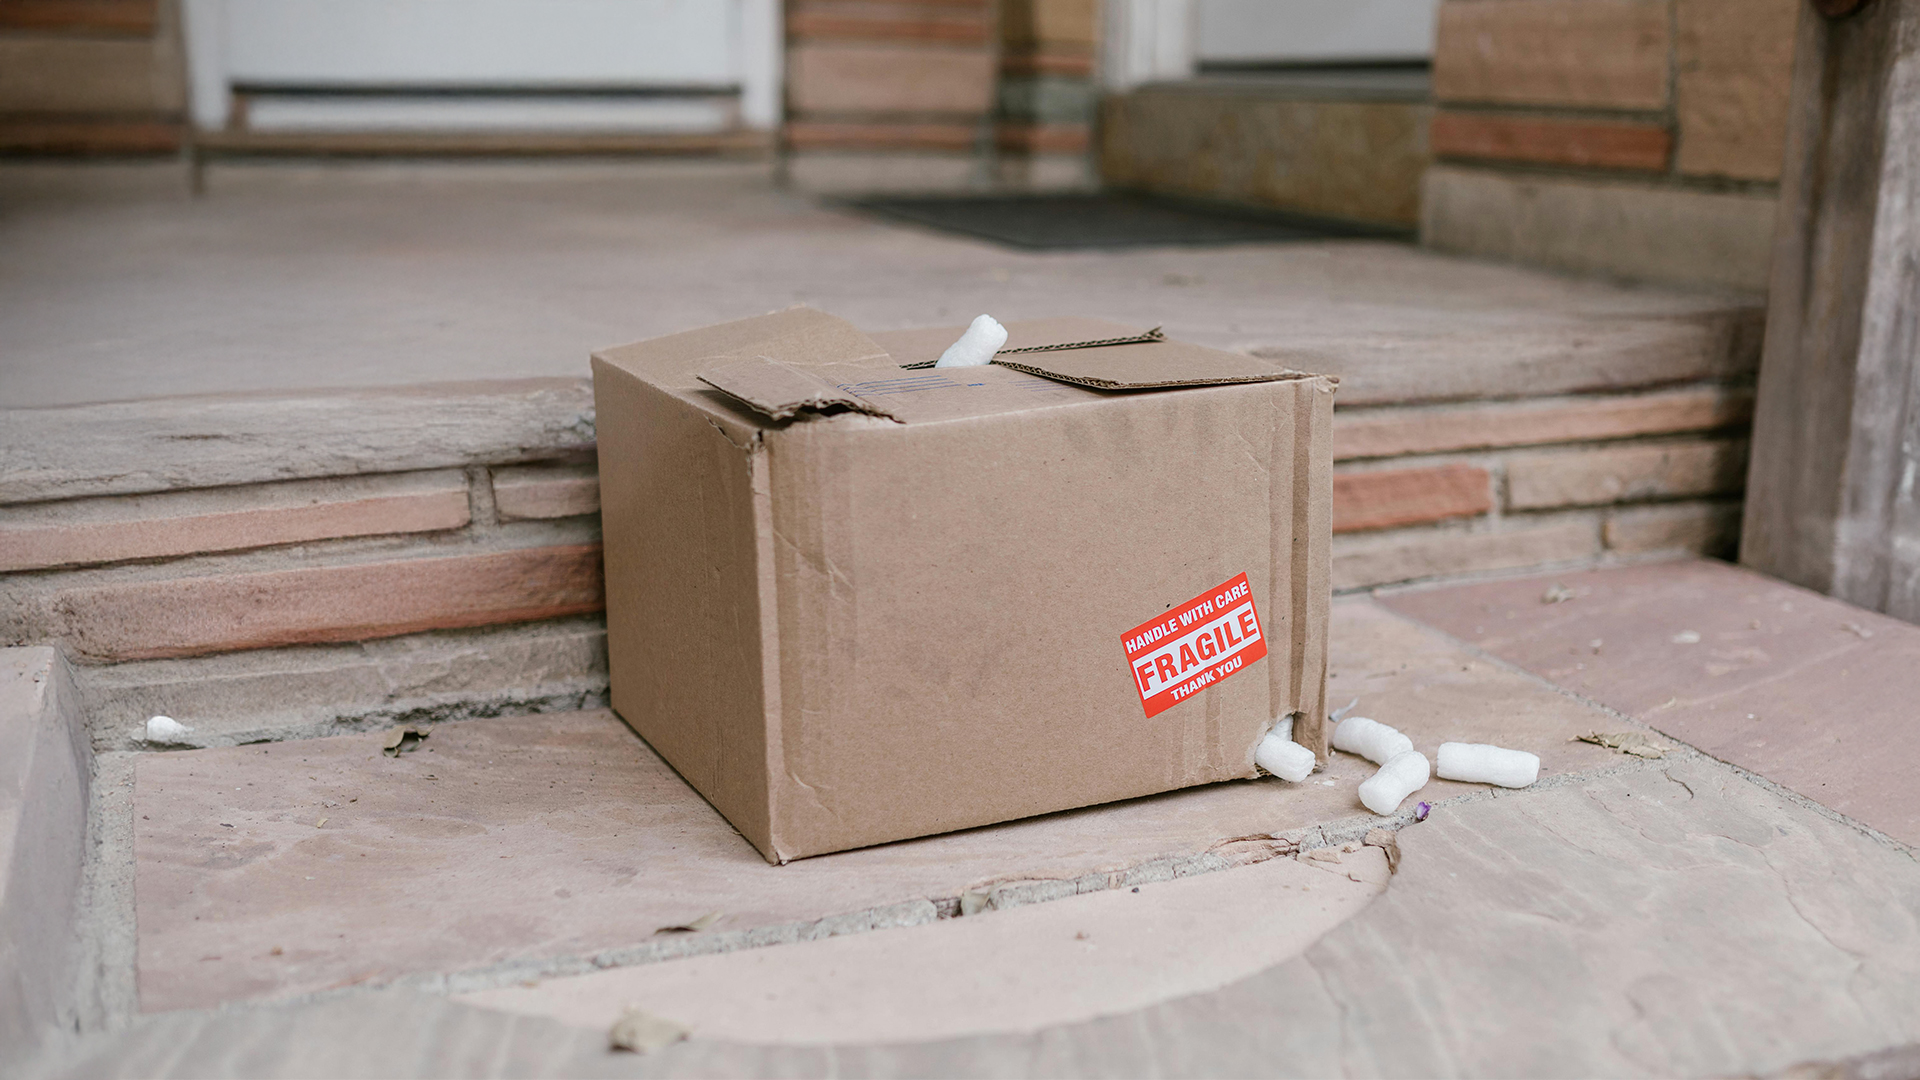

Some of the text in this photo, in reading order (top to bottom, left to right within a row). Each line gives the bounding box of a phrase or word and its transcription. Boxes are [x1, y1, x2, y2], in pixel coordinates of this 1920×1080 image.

[1125, 581, 1249, 654] HANDLE WITH CARE
[1136, 609, 1257, 692] FRAGILE
[1170, 655, 1243, 701] THANK YOU
